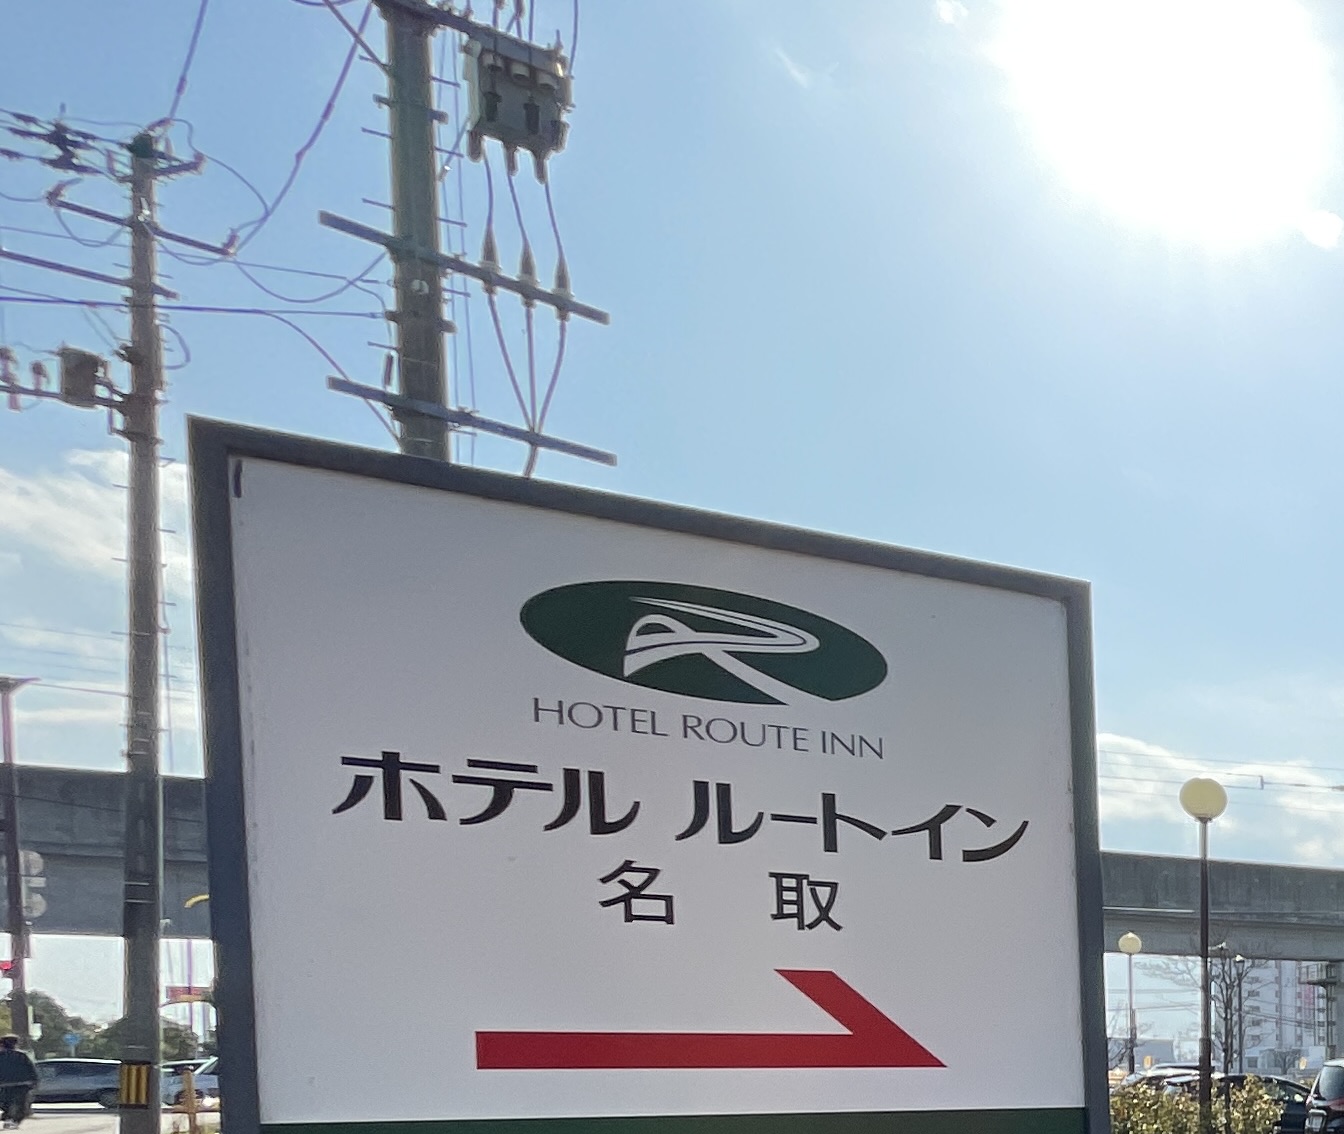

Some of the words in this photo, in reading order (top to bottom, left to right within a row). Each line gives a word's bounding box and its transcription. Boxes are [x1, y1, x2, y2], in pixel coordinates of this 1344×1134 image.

[533, 696, 668, 737] HOTEL
[682, 714, 809, 752] ROUTE
[820, 730, 885, 760] INN
[332, 750, 640, 835] ホテル
[674, 780, 1030, 863] ルートイン
